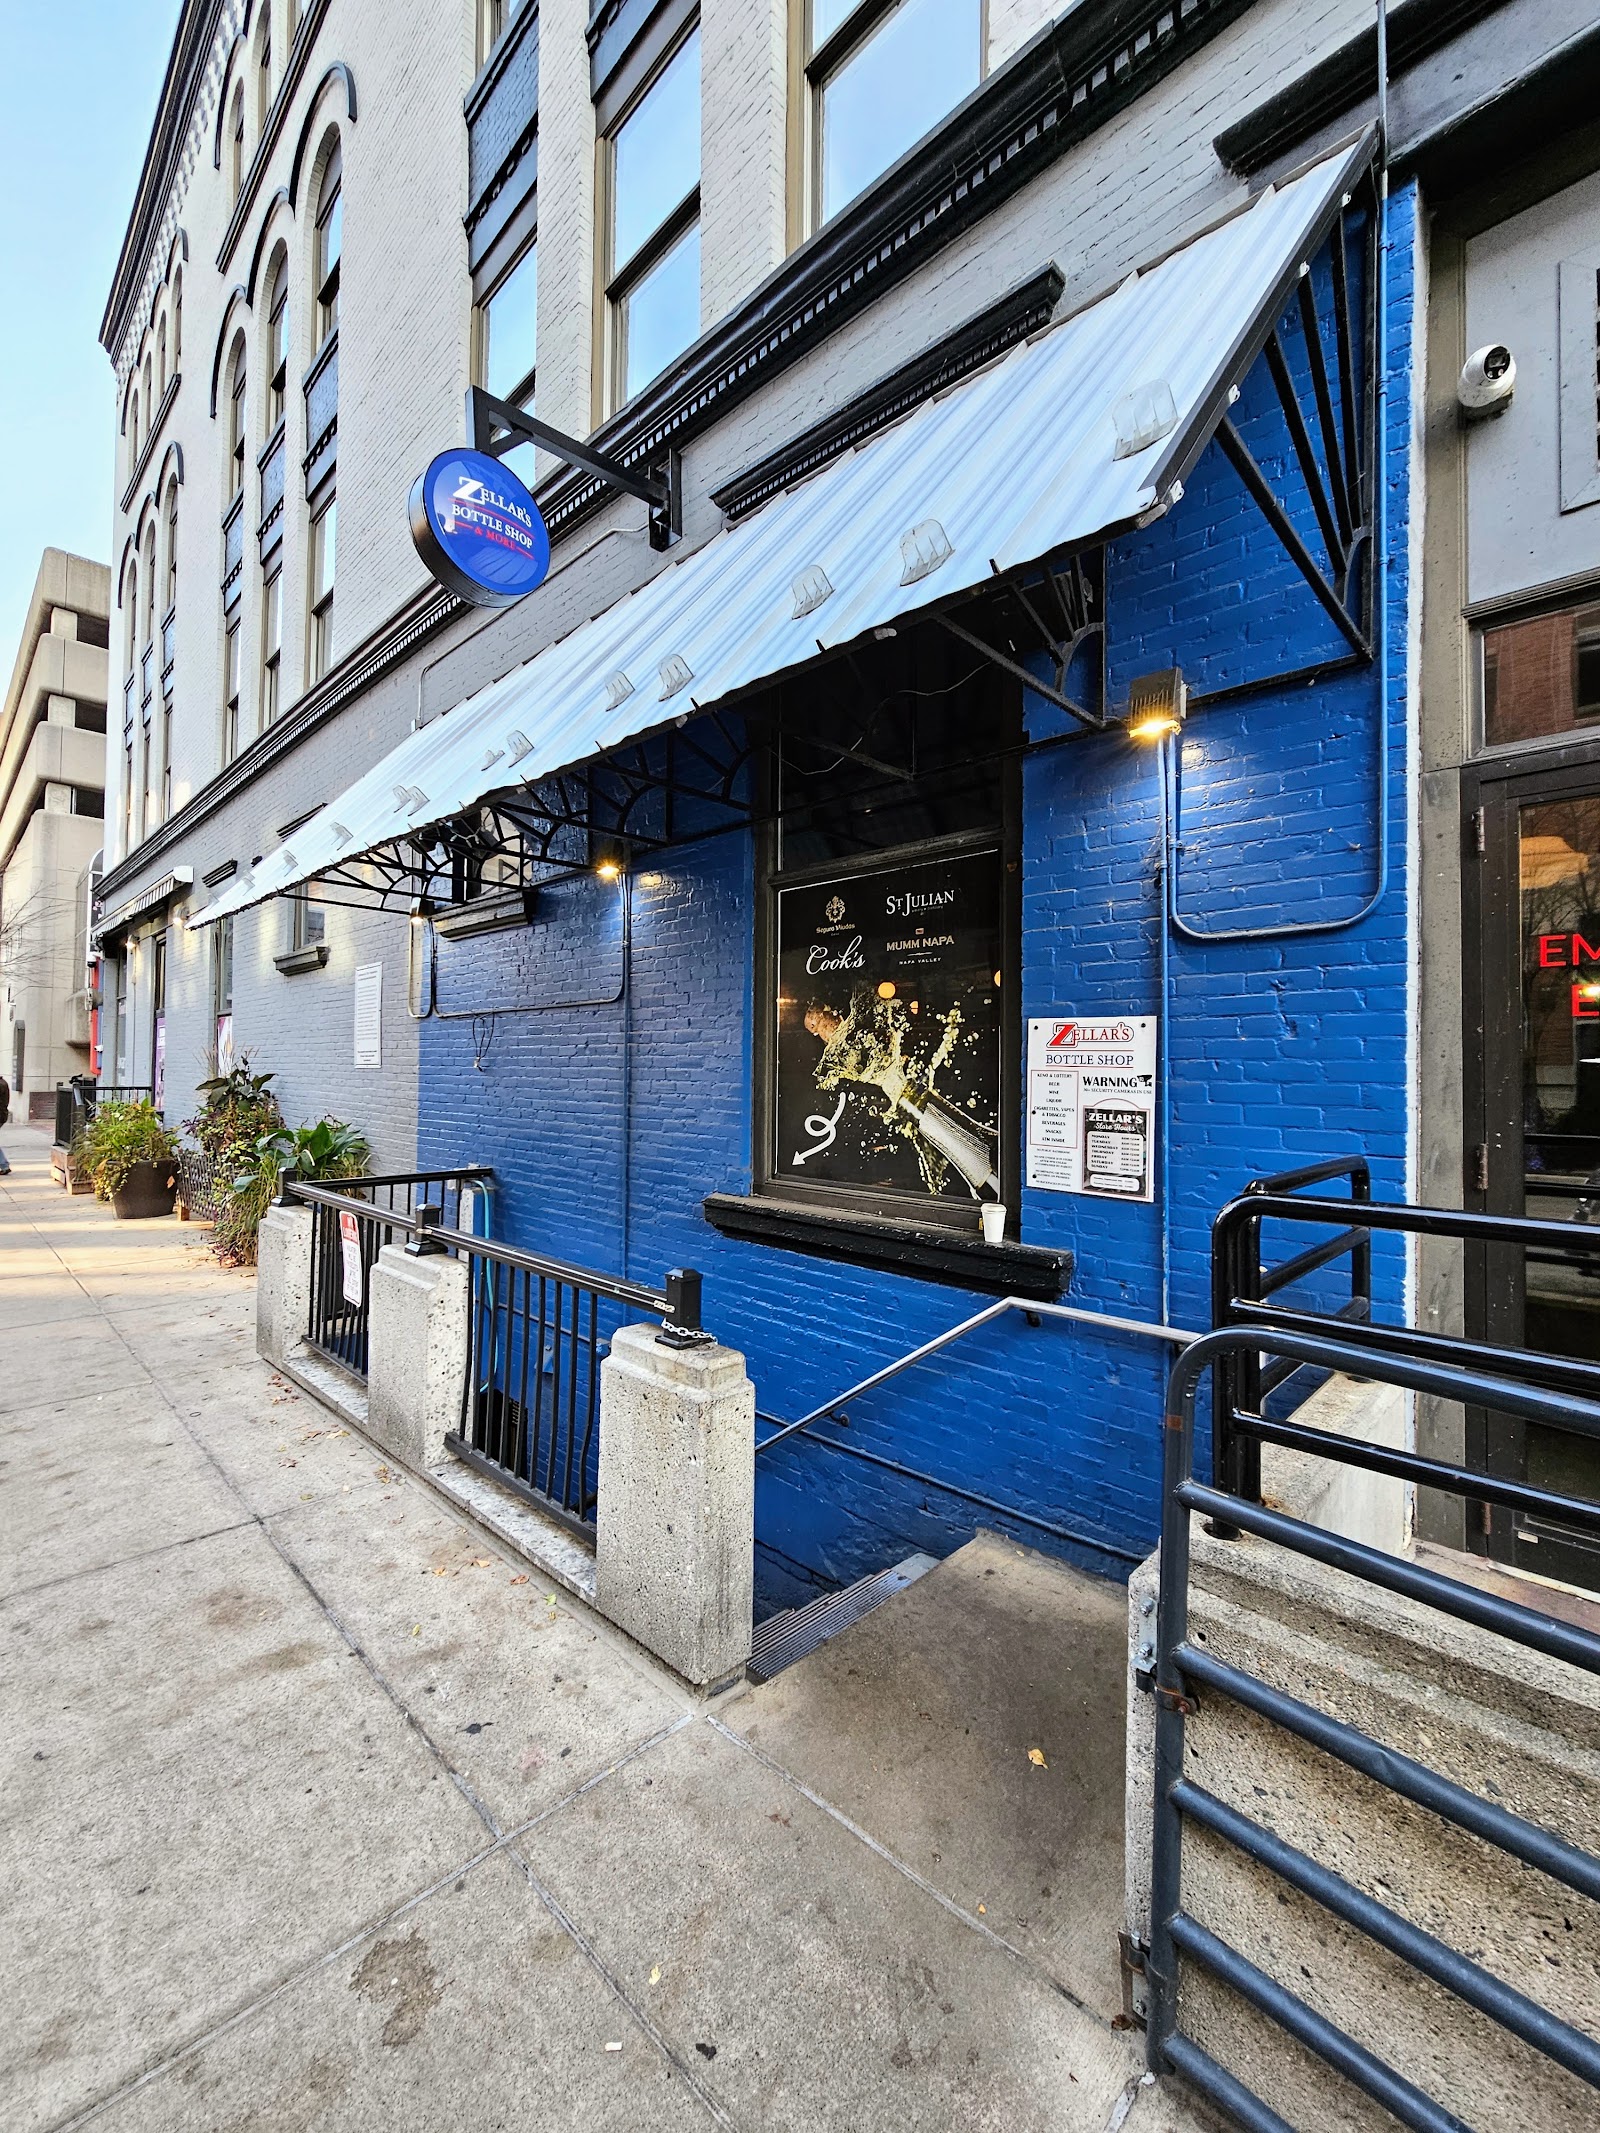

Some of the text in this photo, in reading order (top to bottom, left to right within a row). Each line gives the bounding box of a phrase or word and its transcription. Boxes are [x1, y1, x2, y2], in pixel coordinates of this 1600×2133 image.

[452, 476, 532, 528] ZELLAR'S
[451, 503, 533, 549] BOTTLE SHOP
[474, 526, 516, 551] & MORE
[902, 889, 955, 917] JULIAN
[805, 935, 866, 975] Cook's
[886, 935, 955, 952] MUMM NAPA
[1048, 1024, 1130, 1046] ZELLAR'S
[1046, 1054, 1134, 1066] BOTTLE SHOP
[1082, 1076, 1138, 1088] WARNING
[1088, 1112, 1144, 1124] ZELLAR'S
